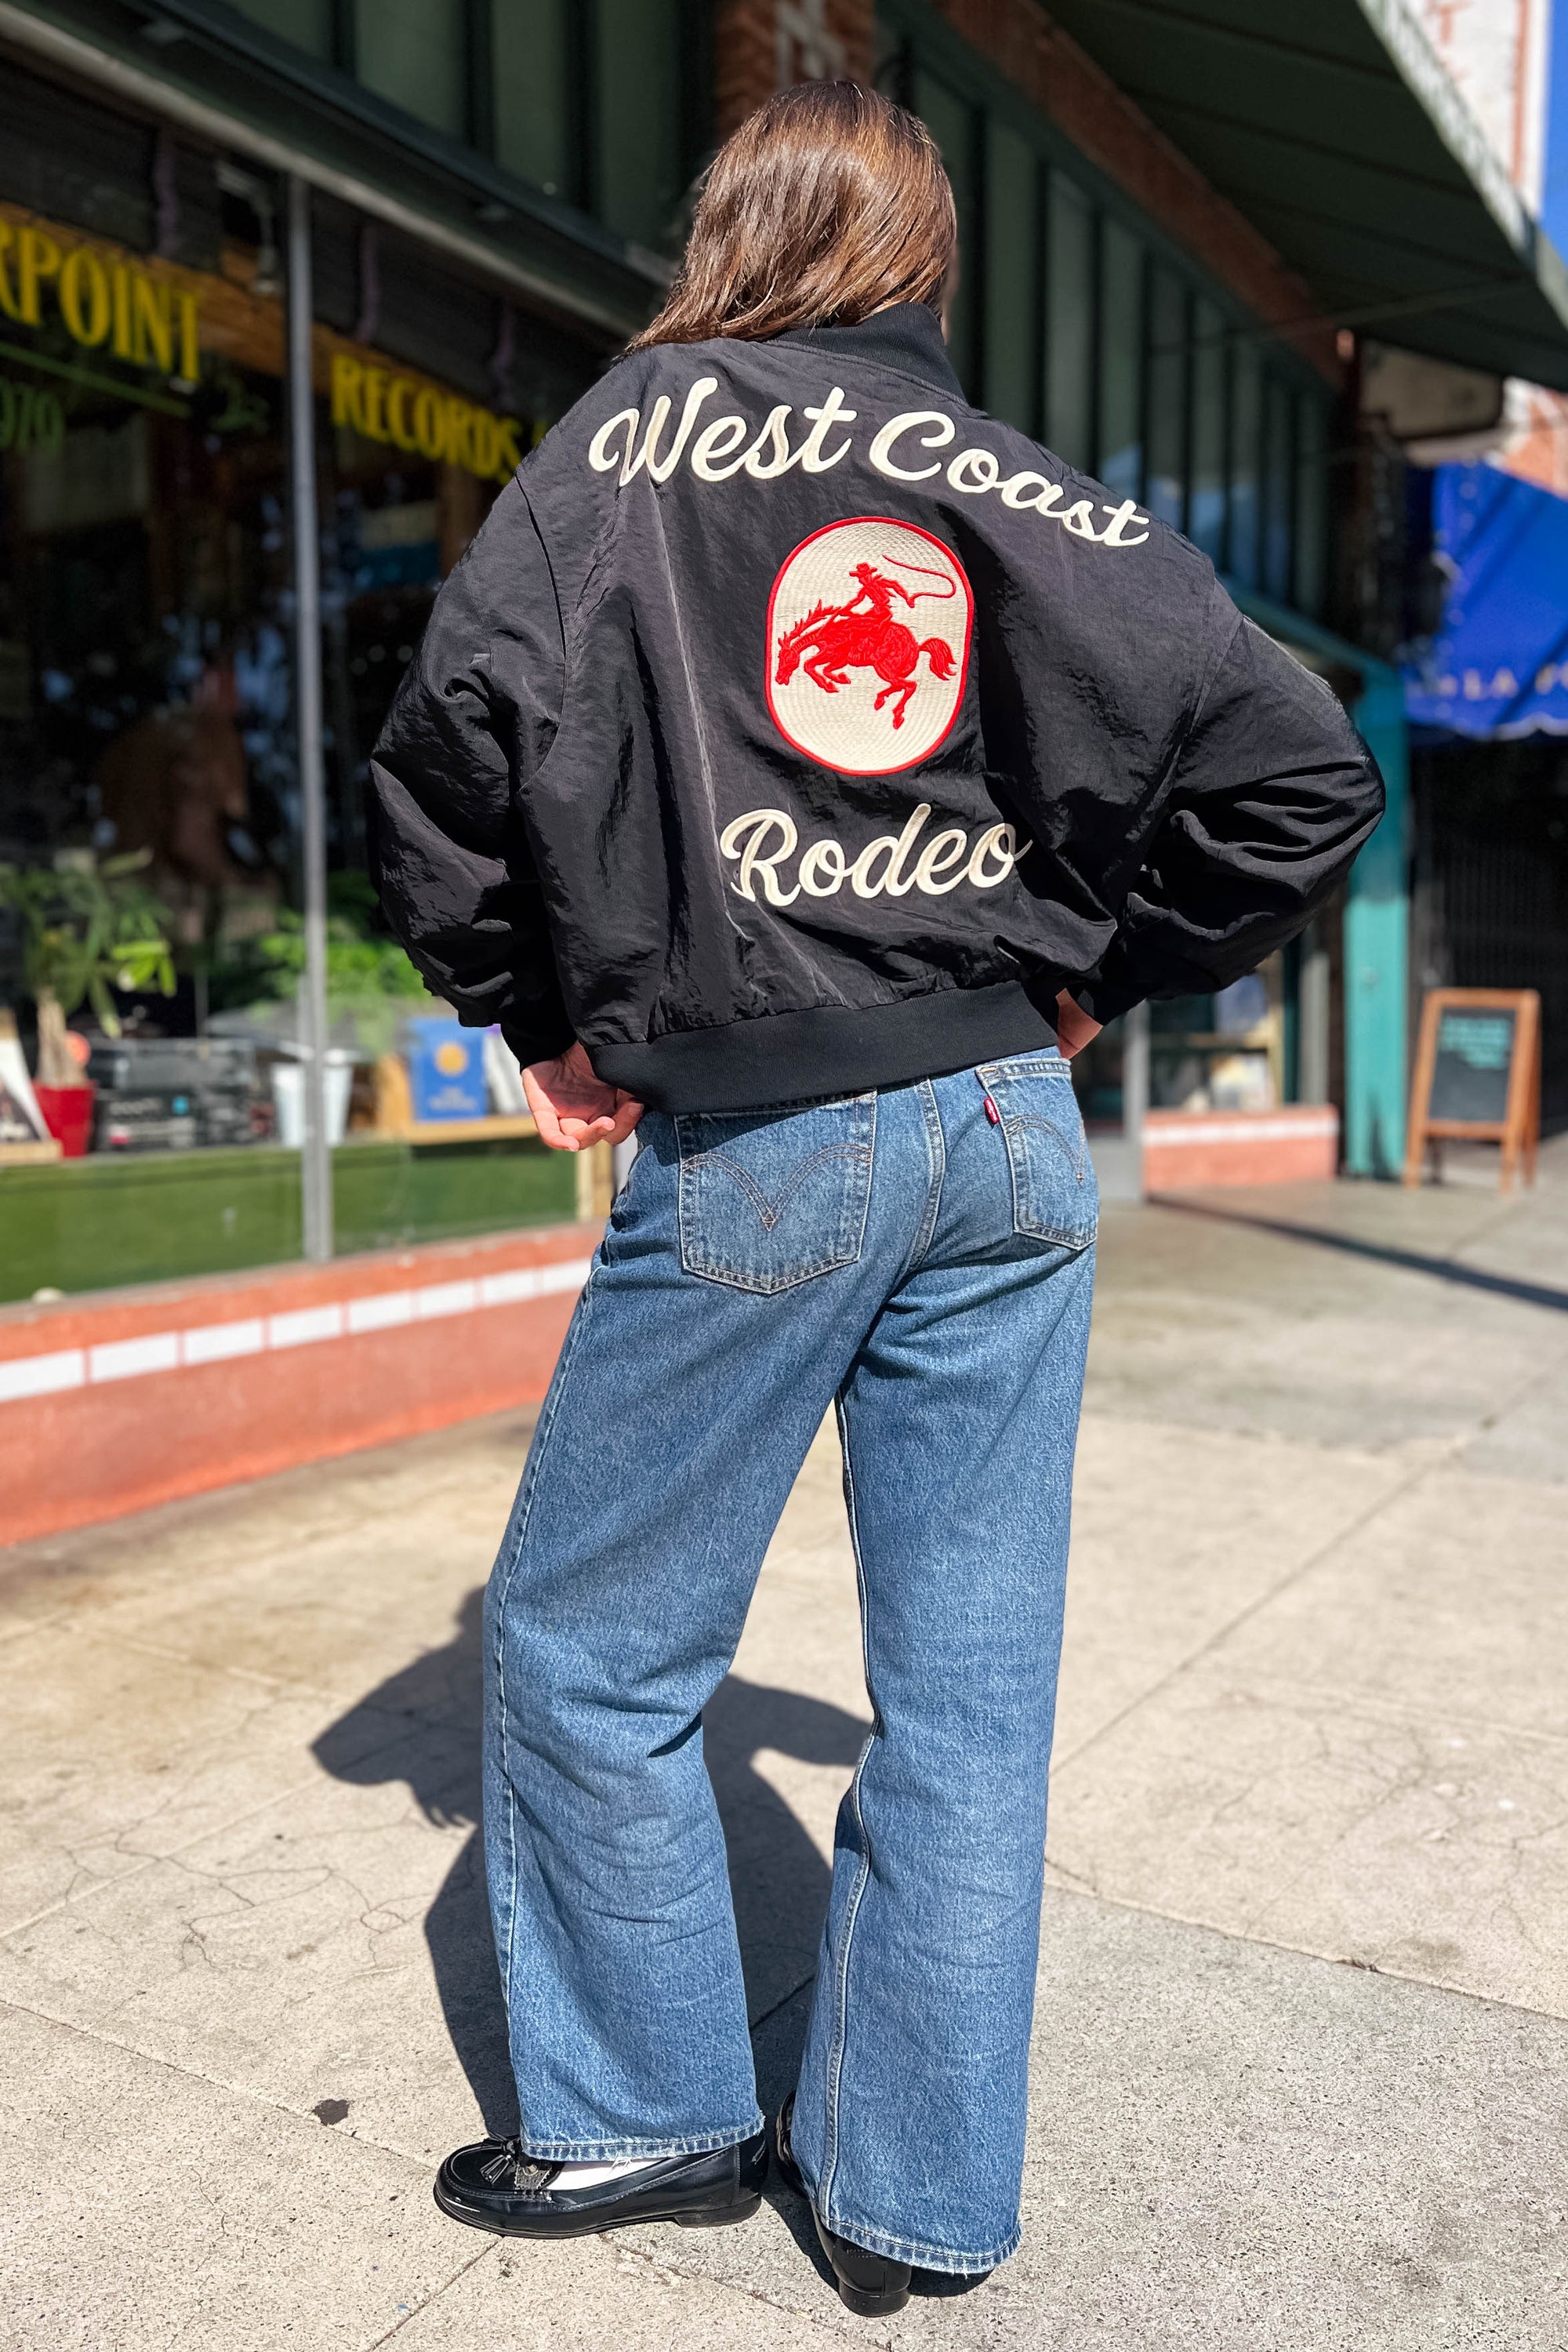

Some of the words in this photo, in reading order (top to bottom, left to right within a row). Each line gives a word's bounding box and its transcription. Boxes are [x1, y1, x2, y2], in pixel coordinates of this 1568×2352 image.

[331, 354, 522, 486] RECORDS
[588, 377, 858, 488] West
[869, 410, 1150, 547] Coast
[719, 803, 1033, 907] Rodeo
